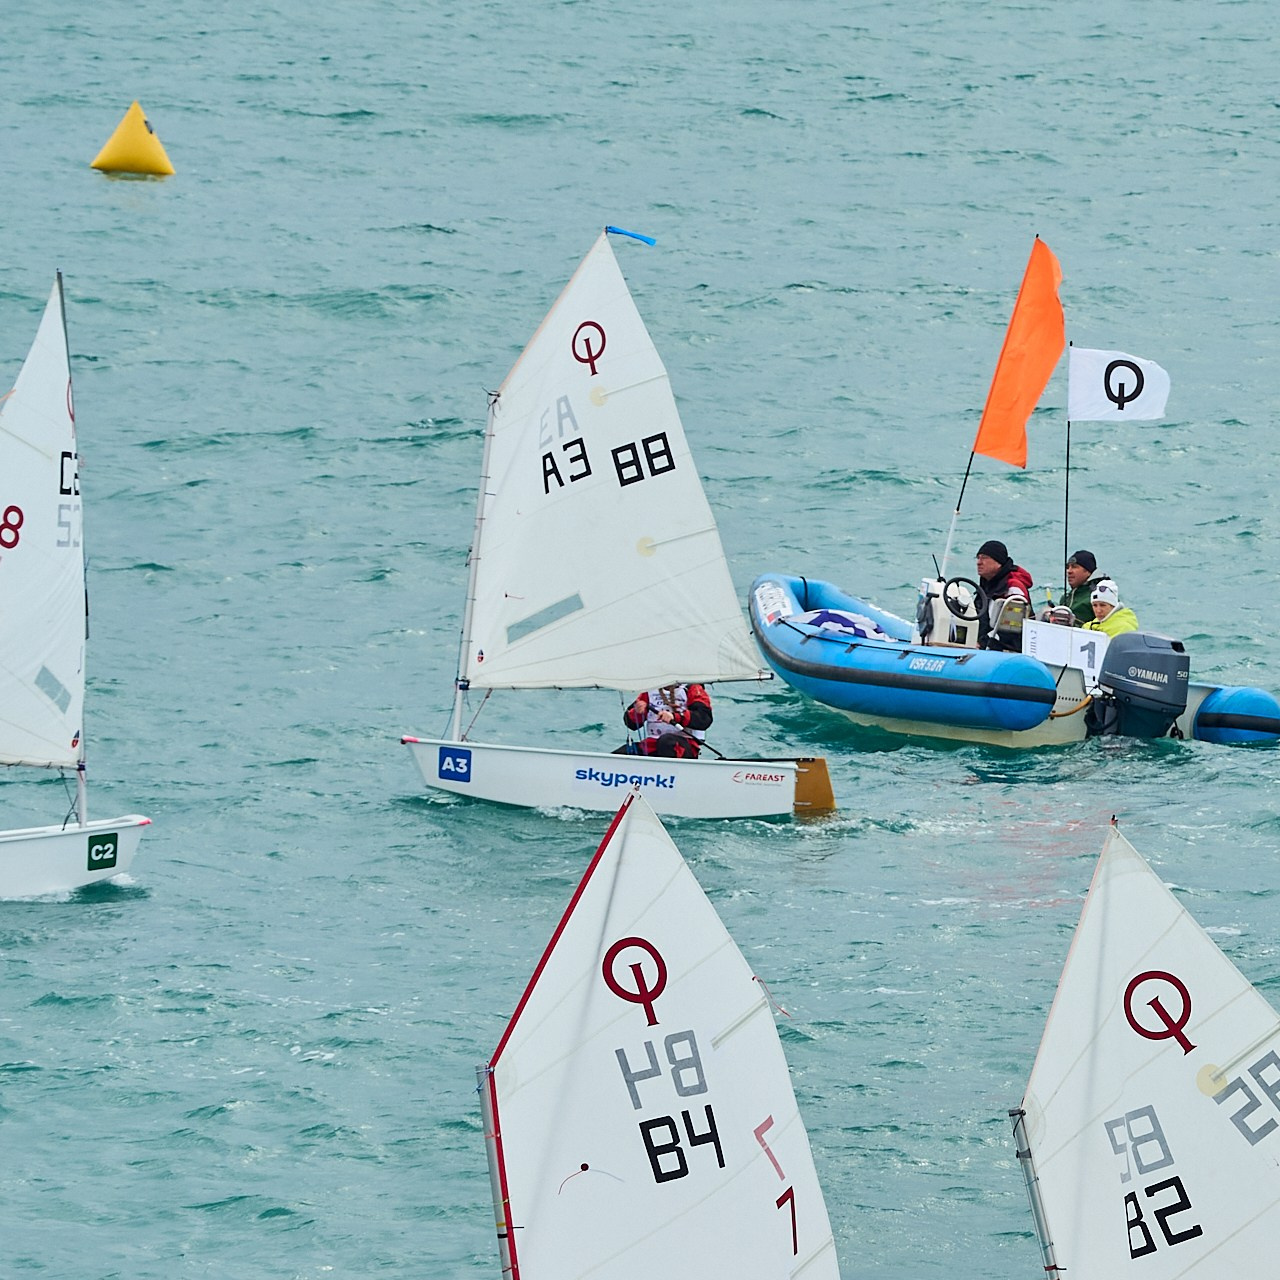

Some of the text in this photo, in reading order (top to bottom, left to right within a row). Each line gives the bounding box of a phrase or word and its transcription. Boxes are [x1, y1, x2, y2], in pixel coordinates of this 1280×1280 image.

[542, 432, 676, 494] A3 88
[1080, 641, 1096, 669] 1
[1136, 668, 1168, 684] YAMAHA
[442, 757, 468, 773] A3
[575, 768, 676, 789] skypark!
[745, 773, 785, 782] FAREAST
[91, 843, 114, 860] C2
[638, 1104, 725, 1183] B4
[776, 1185, 798, 1256] 7
[1124, 1175, 1203, 1259] B2
